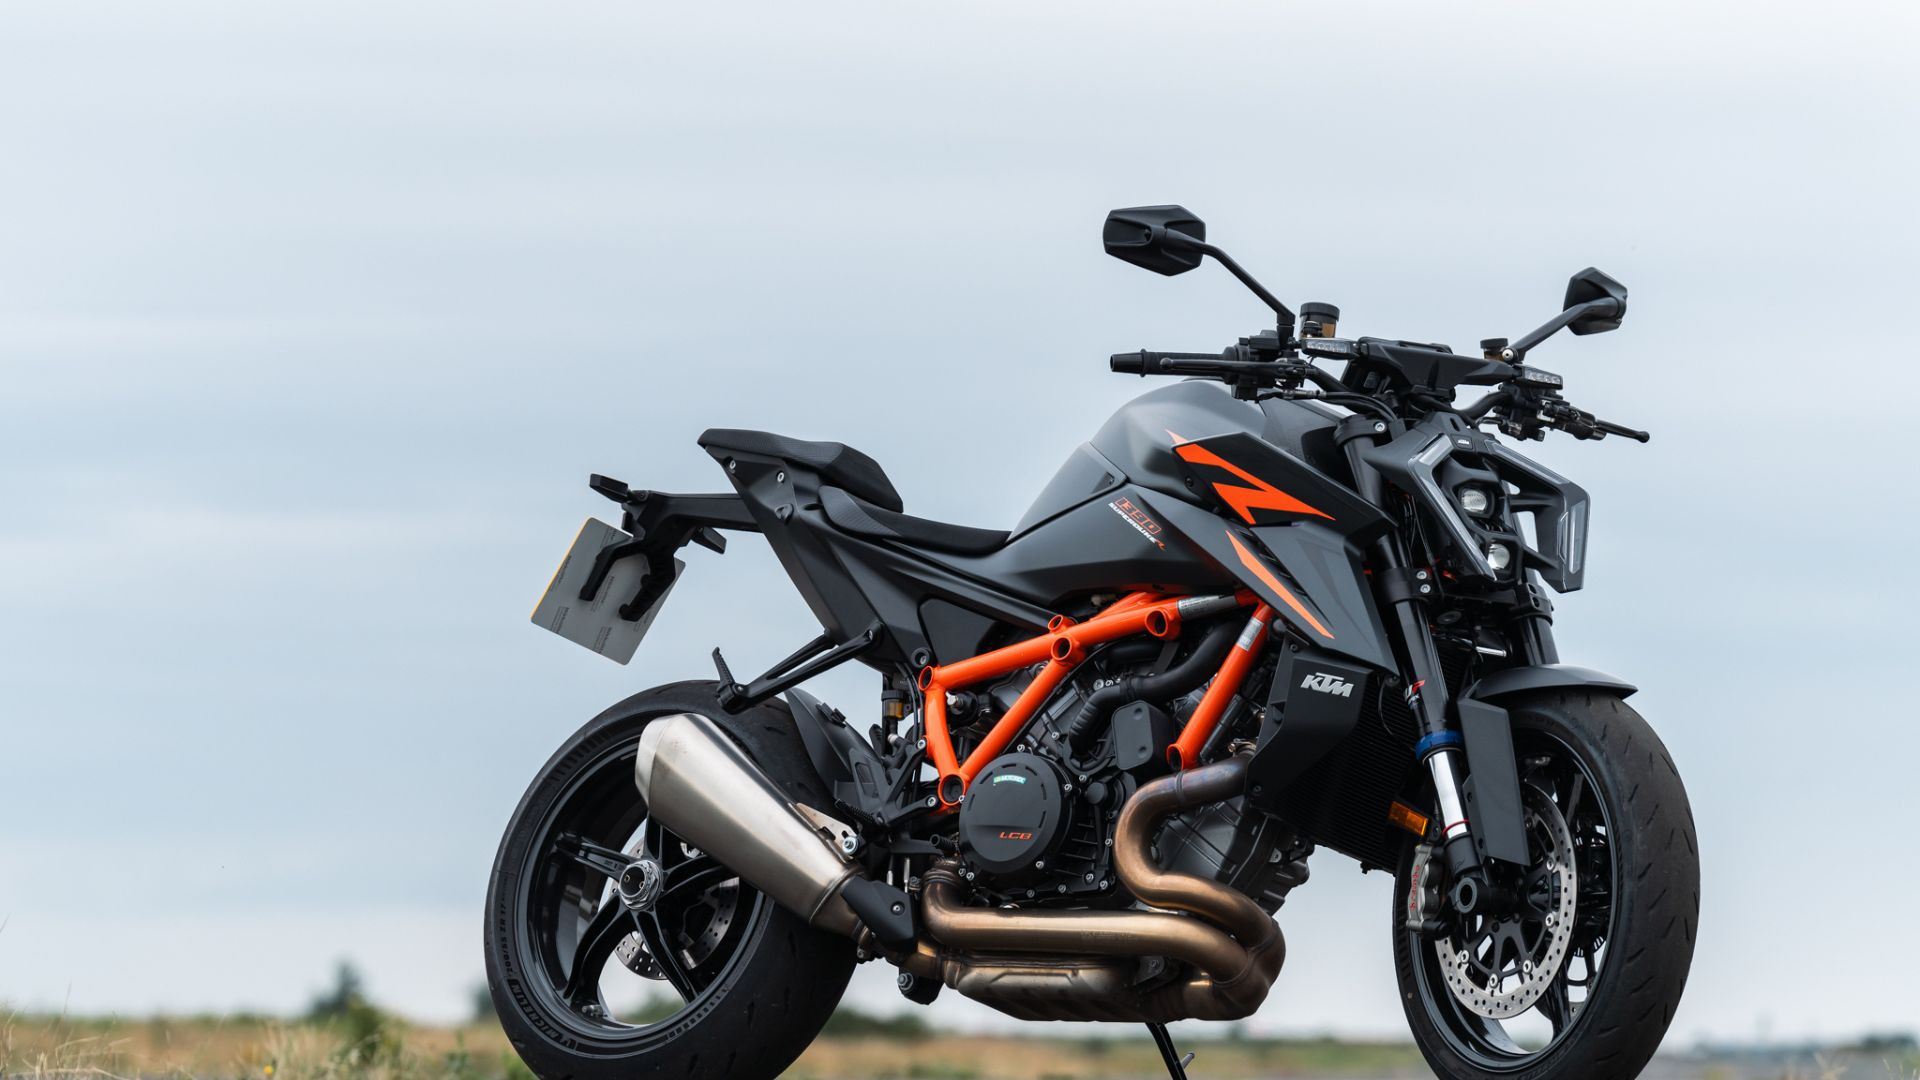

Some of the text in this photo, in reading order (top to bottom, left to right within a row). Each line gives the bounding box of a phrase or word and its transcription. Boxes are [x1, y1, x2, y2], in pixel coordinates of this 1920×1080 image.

[1300, 671, 1354, 698] KTM
[1000, 831, 1032, 840] LC8
[510, 983, 560, 1039] MICHELIN
